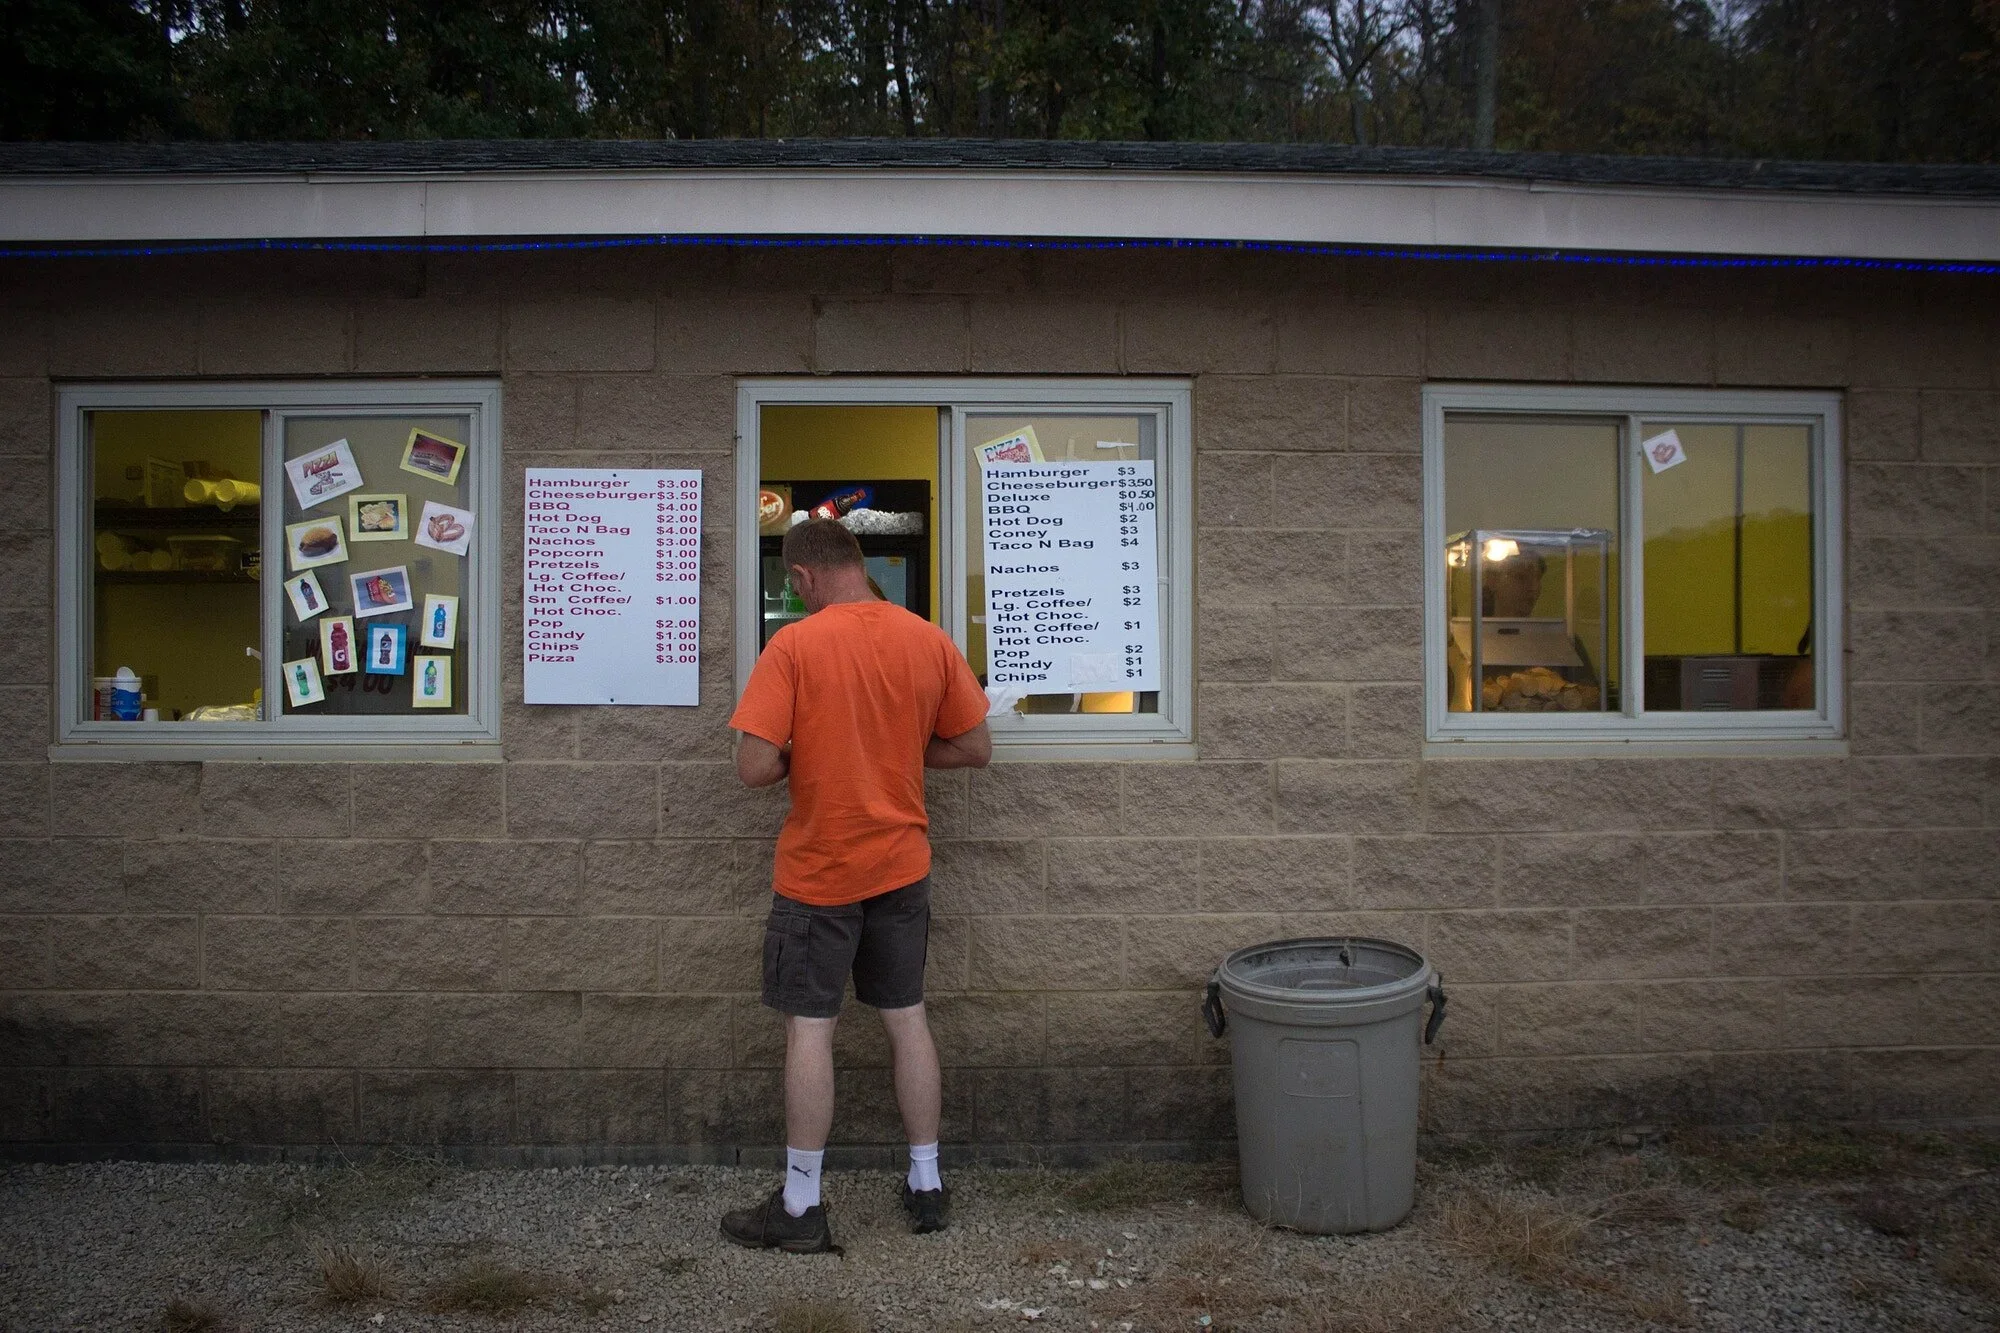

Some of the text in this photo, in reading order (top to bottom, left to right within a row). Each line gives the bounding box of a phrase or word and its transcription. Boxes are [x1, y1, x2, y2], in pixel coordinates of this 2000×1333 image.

[302, 451, 339, 478] PIZZA
[986, 466, 1136, 479] Hamburger $3
[529, 478, 698, 490] Hamburger $3.00
[987, 480, 1118, 491] Cheeseburger
[528, 489, 698, 501] Cheeseburger $3.50
[987, 489, 1156, 503] Deluxe $0.50
[528, 501, 698, 512] BBQ $4.00
[988, 501, 1155, 515] BBQ $4.00
[528, 513, 698, 525] Hot Dog $2.00
[988, 514, 1138, 527] Hot Dog $2
[527, 525, 698, 536] Taco N Bag $4.00
[988, 525, 1139, 539] Coney $3
[528, 536, 697, 547] Nachos $3.00
[988, 537, 1140, 551] Taco N Bag $4
[528, 548, 697, 559] Popcorn $1.00
[528, 560, 697, 571] Pretzels $3.00
[990, 561, 1140, 575] Nachos $3
[528, 571, 697, 583] Lg. Coffee/ $2.00
[533, 583, 622, 593] Hot Choc.
[991, 585, 1141, 599] Pretzels $3
[527, 595, 697, 606] Sm Coffee/ $1.00
[991, 597, 1142, 613] Lg. Coffee/ $2
[533, 606, 622, 616] Hot Choc.
[997, 611, 1089, 623] Hot Choc.
[528, 618, 697, 630] Pop $2.00
[992, 620, 1141, 635] Sm. Coffee/ $1
[528, 630, 697, 641] Candy $1.00
[998, 635, 1090, 647] Hot Choc.
[528, 641, 580, 653] Chips
[993, 644, 1143, 660] Pop $2
[334, 648, 347, 662] G
[528, 653, 697, 664] Pizza $3.00
[994, 656, 1142, 671] Candy $1
[994, 668, 1143, 683] Chips $1
